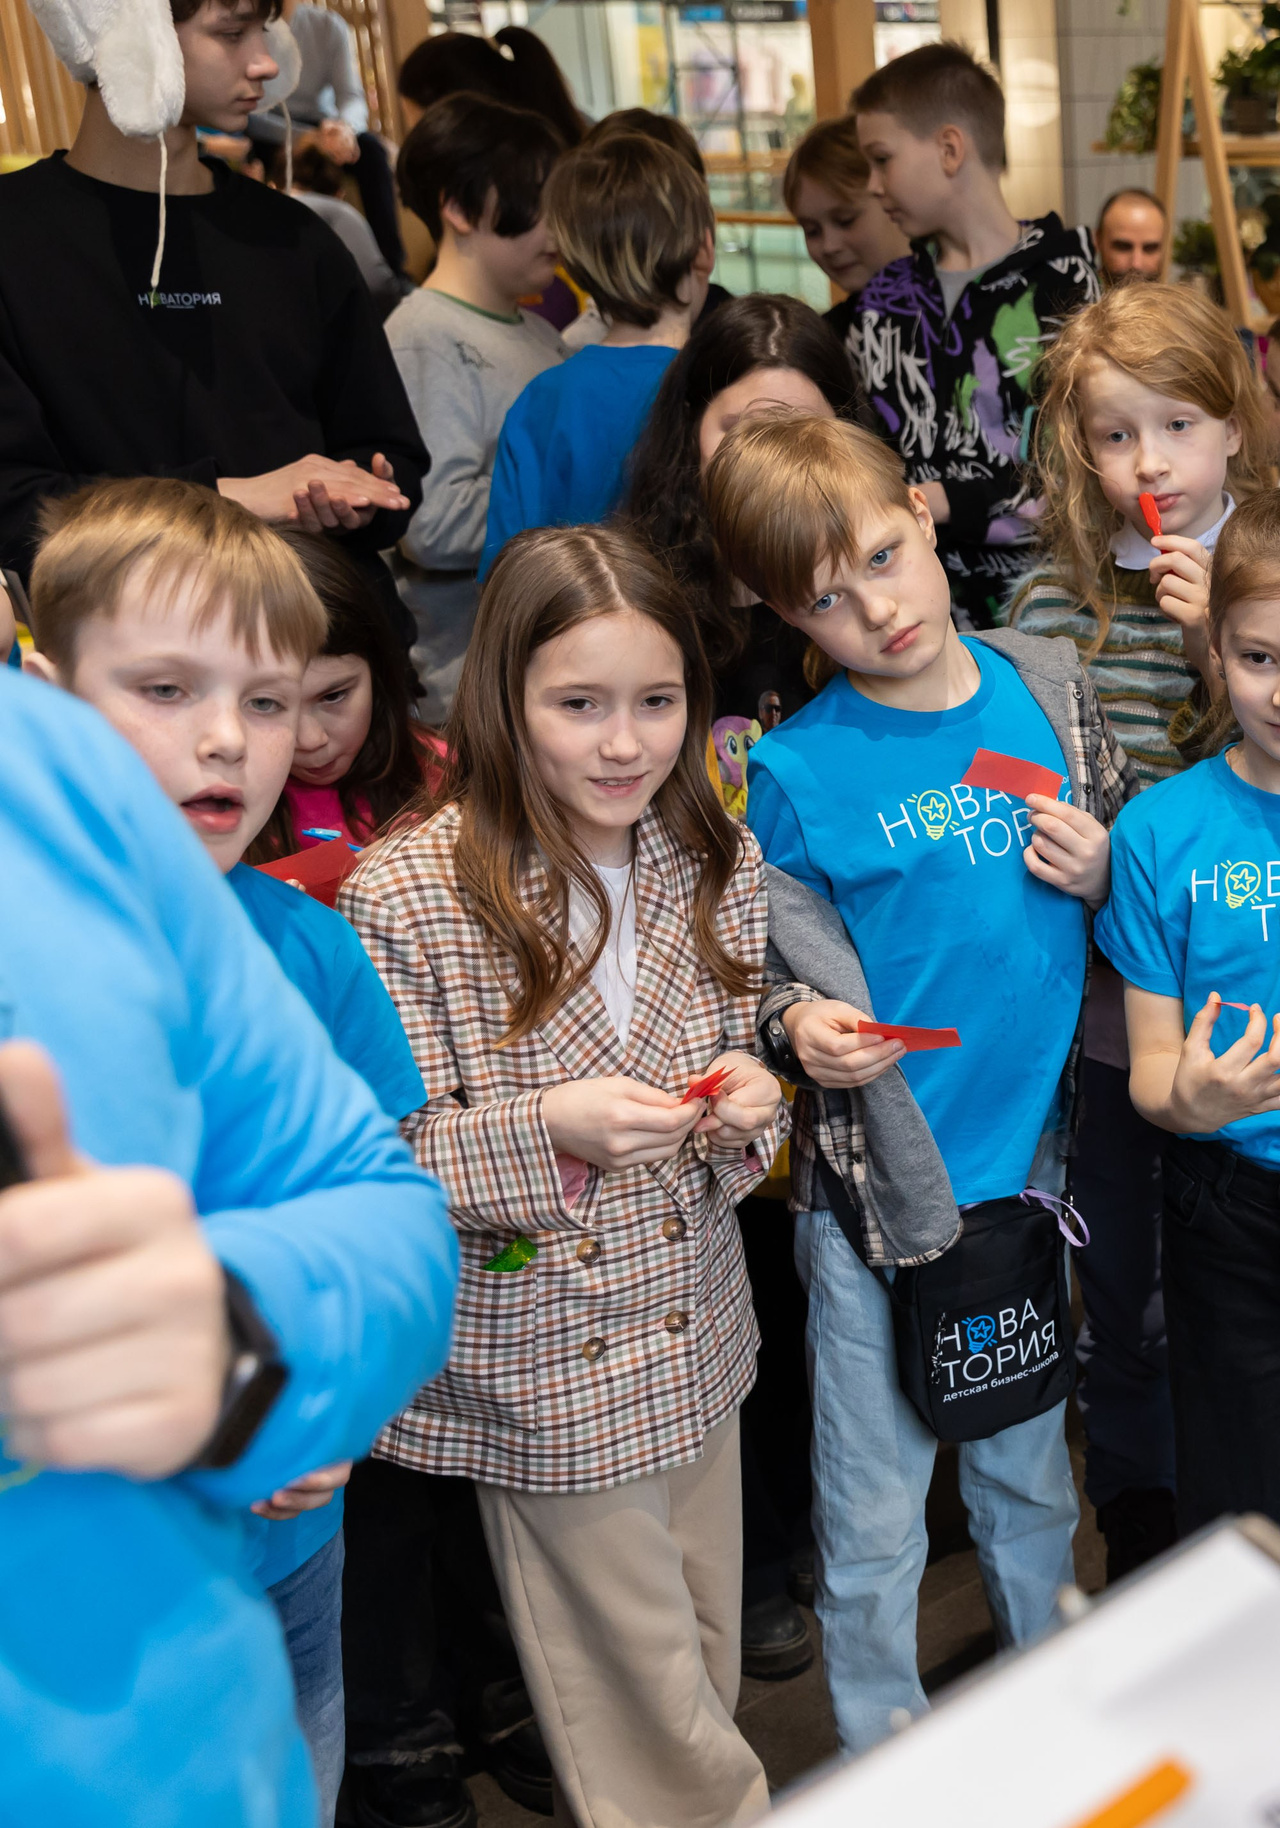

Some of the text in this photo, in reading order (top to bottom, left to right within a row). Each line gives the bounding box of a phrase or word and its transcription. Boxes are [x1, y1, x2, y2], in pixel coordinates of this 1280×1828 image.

[941, 1320, 1056, 1388] ТОРИЯ
[943, 1350, 1060, 1403] детская бизнес-школа
